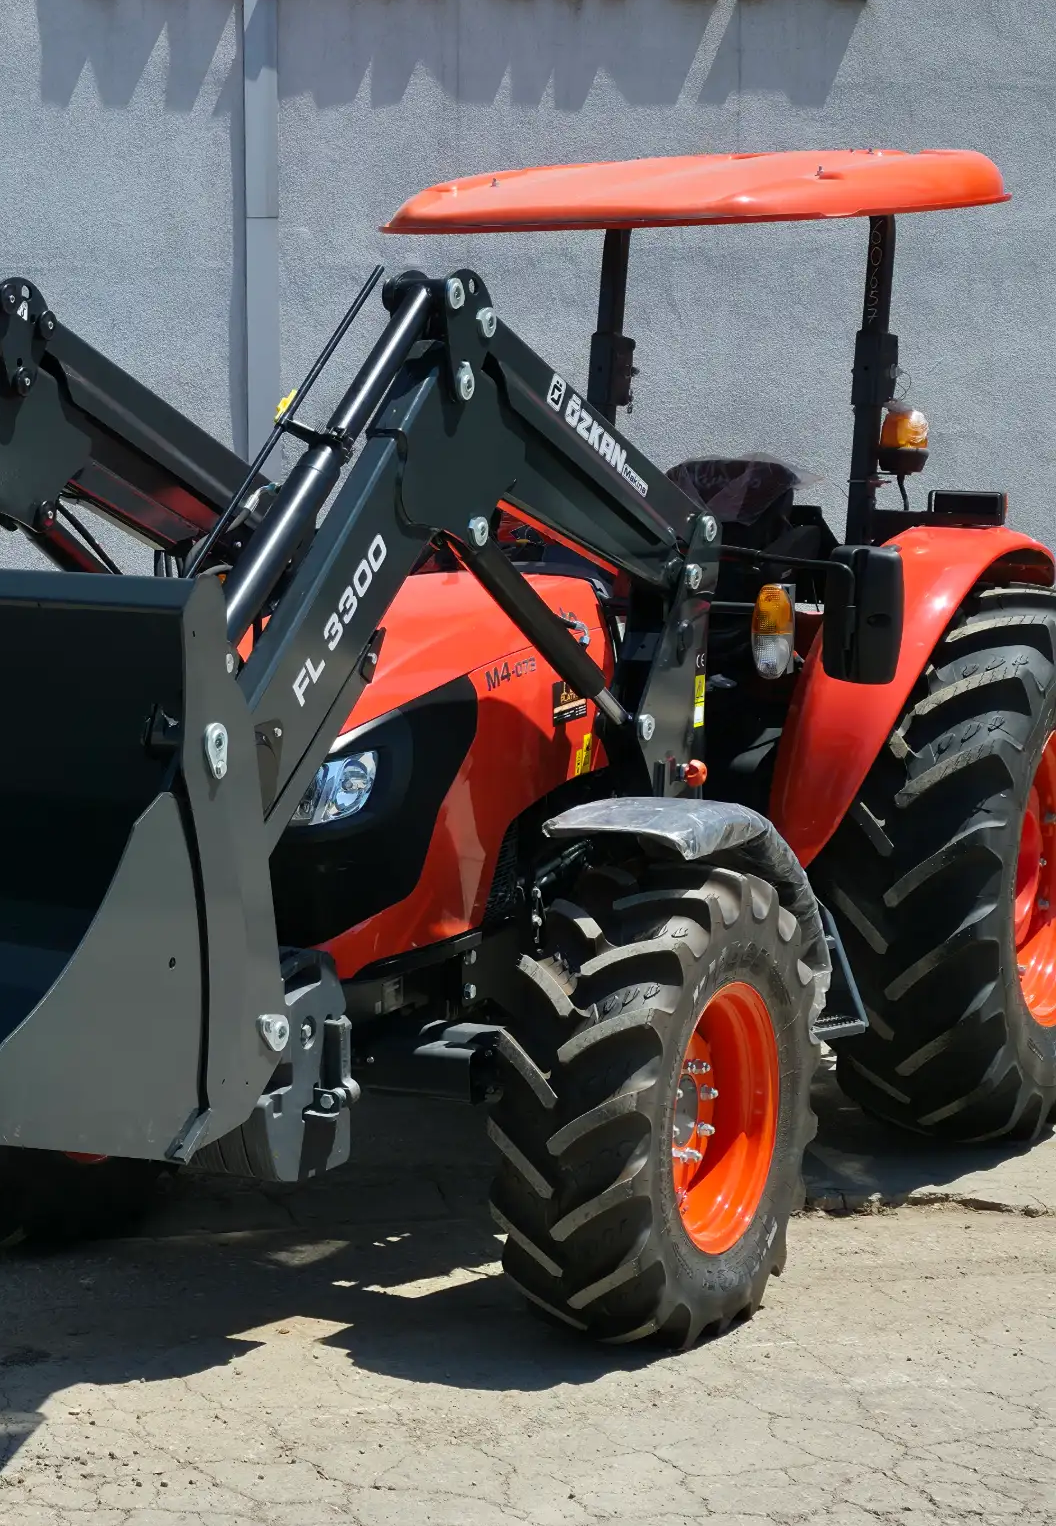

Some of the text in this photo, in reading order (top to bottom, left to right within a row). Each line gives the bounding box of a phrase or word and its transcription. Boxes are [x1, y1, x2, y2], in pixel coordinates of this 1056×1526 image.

[564, 393, 627, 475] ÖZKAN
[292, 533, 387, 707] FL 3300
